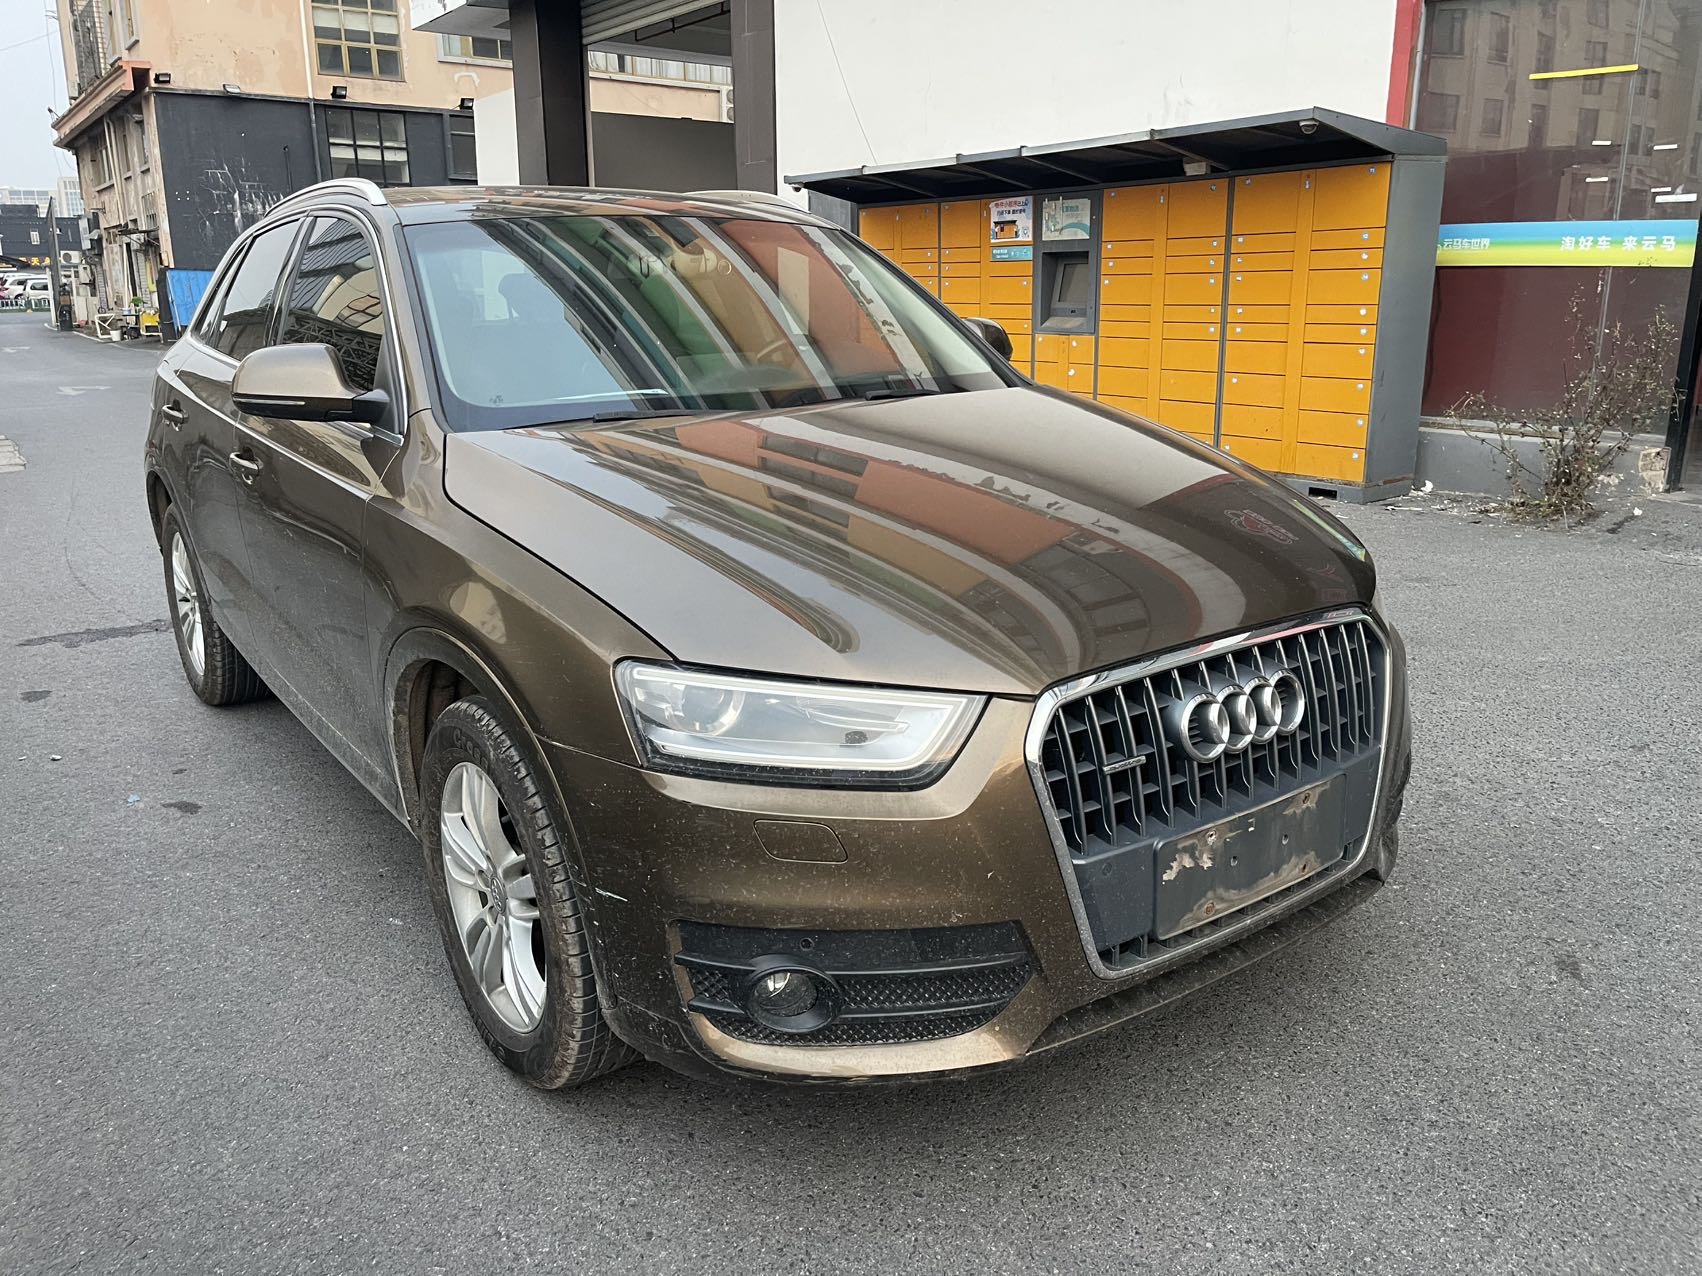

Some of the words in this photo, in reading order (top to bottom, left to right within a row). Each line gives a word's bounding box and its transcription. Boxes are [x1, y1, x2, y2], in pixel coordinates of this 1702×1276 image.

[1443, 238, 1490, 250] 云马车世界
[1560, 235, 1611, 251] 淘好车
[1622, 235, 1676, 251] 来云马
